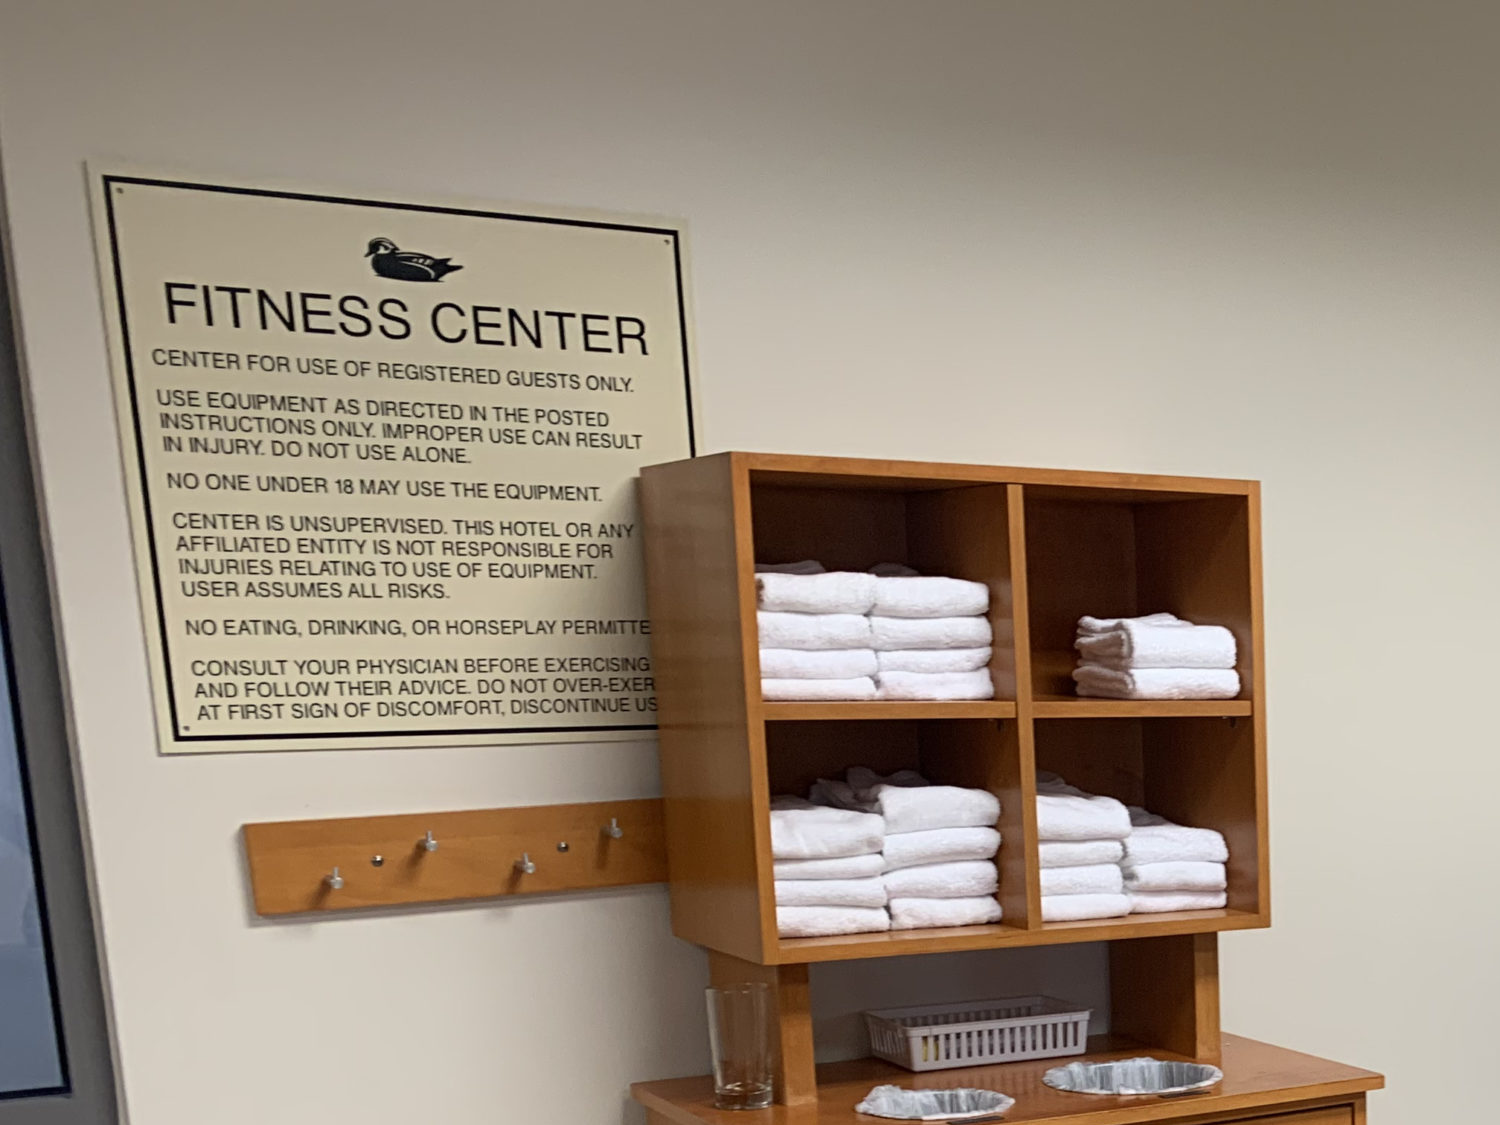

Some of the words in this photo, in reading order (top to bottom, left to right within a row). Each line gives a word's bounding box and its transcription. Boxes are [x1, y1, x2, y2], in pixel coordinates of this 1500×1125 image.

[163, 281, 412, 341] FITNESS
[430, 301, 650, 356] CENTER
[151, 348, 241, 371] CENTER
[245, 353, 292, 373] FOR
[296, 357, 339, 376] USE
[342, 359, 372, 378] OF
[376, 361, 502, 385] REGISTERED
[505, 369, 582, 391] GUESTS
[585, 374, 635, 393] ONLY.
[155, 389, 202, 408] USE
[206, 391, 329, 414] EQUIPMENT
[333, 398, 362, 416] AS
[365, 399, 464, 421] DIRECTED
[468, 405, 488, 422] IN
[490, 406, 531, 424] THE
[534, 408, 610, 428] POSTED
[159, 412, 317, 436] INSTRUCTIONS
[321, 419, 377, 439] ONLY.
[381, 422, 484, 443] IMPROPER
[488, 427, 528, 446] USE
[531, 429, 571, 447] CAN
[575, 431, 644, 450] RESULT
[162, 435, 184, 453] IN
[188, 436, 266, 456] INJURY.
[270, 439, 303, 458] DO
[307, 441, 351, 460] NOT
[355, 443, 398, 462] USE
[401, 445, 472, 464] ALONE.
[166, 472, 201, 490] NO
[204, 473, 252, 492] ONE
[255, 475, 329, 494] UNDER
[334, 478, 355, 495] 18
[358, 478, 401, 496] MAY
[405, 480, 447, 498] USE
[449, 481, 490, 499] THE
[493, 483, 603, 502] EQUIPMENT.
[172, 511, 261, 531] CENTER
[265, 514, 285, 532] IS
[289, 515, 448, 535] UNSUPERVISED.
[451, 519, 495, 537] THIS
[499, 520, 562, 538] HOTEL
[565, 521, 594, 538] OR
[597, 523, 635, 539] ANY
[175, 535, 292, 554] AFFILIATED
[295, 537, 368, 555] ENTITY
[372, 538, 392, 556] IS
[395, 539, 437, 557] NOT
[441, 540, 573, 559] RESPONSIBLE
[575, 542, 615, 560] FOR
[178, 558, 274, 576] INJURIES
[278, 559, 377, 577] RELATING
[379, 561, 408, 578] TO
[411, 561, 453, 578] USE
[456, 562, 483, 579] OF
[487, 562, 598, 580] EQUIPMENT.
[180, 580, 240, 598] USER
[244, 581, 344, 599] ASSUMES
[347, 582, 384, 599] ALL
[387, 582, 451, 600] RISKS.
[184, 618, 218, 637] NO
[222, 619, 303, 638] EATING,
[307, 619, 407, 638] DRINKING,
[411, 619, 442, 636] OR
[445, 619, 558, 636] HORSEPLAY
[562, 619, 652, 635] PERMITTE
[190, 659, 289, 677] CONSULT
[293, 659, 351, 676] YOUR
[355, 658, 459, 675] PHYSICIAN
[463, 657, 540, 674] BEFORE
[543, 657, 651, 675] EXERCISING
[194, 681, 239, 699] AND
[243, 680, 331, 699] FOLLOW
[333, 680, 393, 697] THEIR
[397, 678, 472, 696] ADVICE.
[476, 678, 506, 695] DO
[509, 677, 549, 694] NOT
[552, 676, 656, 695] OVER-EXER
[196, 704, 223, 721] AT
[227, 703, 286, 721] FIRST
[290, 702, 339, 720] SIGN
[343, 701, 372, 719] OF
[376, 699, 506, 718] DISCOMFORT,
[509, 696, 631, 715] DISCONTINUE
[635, 697, 658, 713] US
